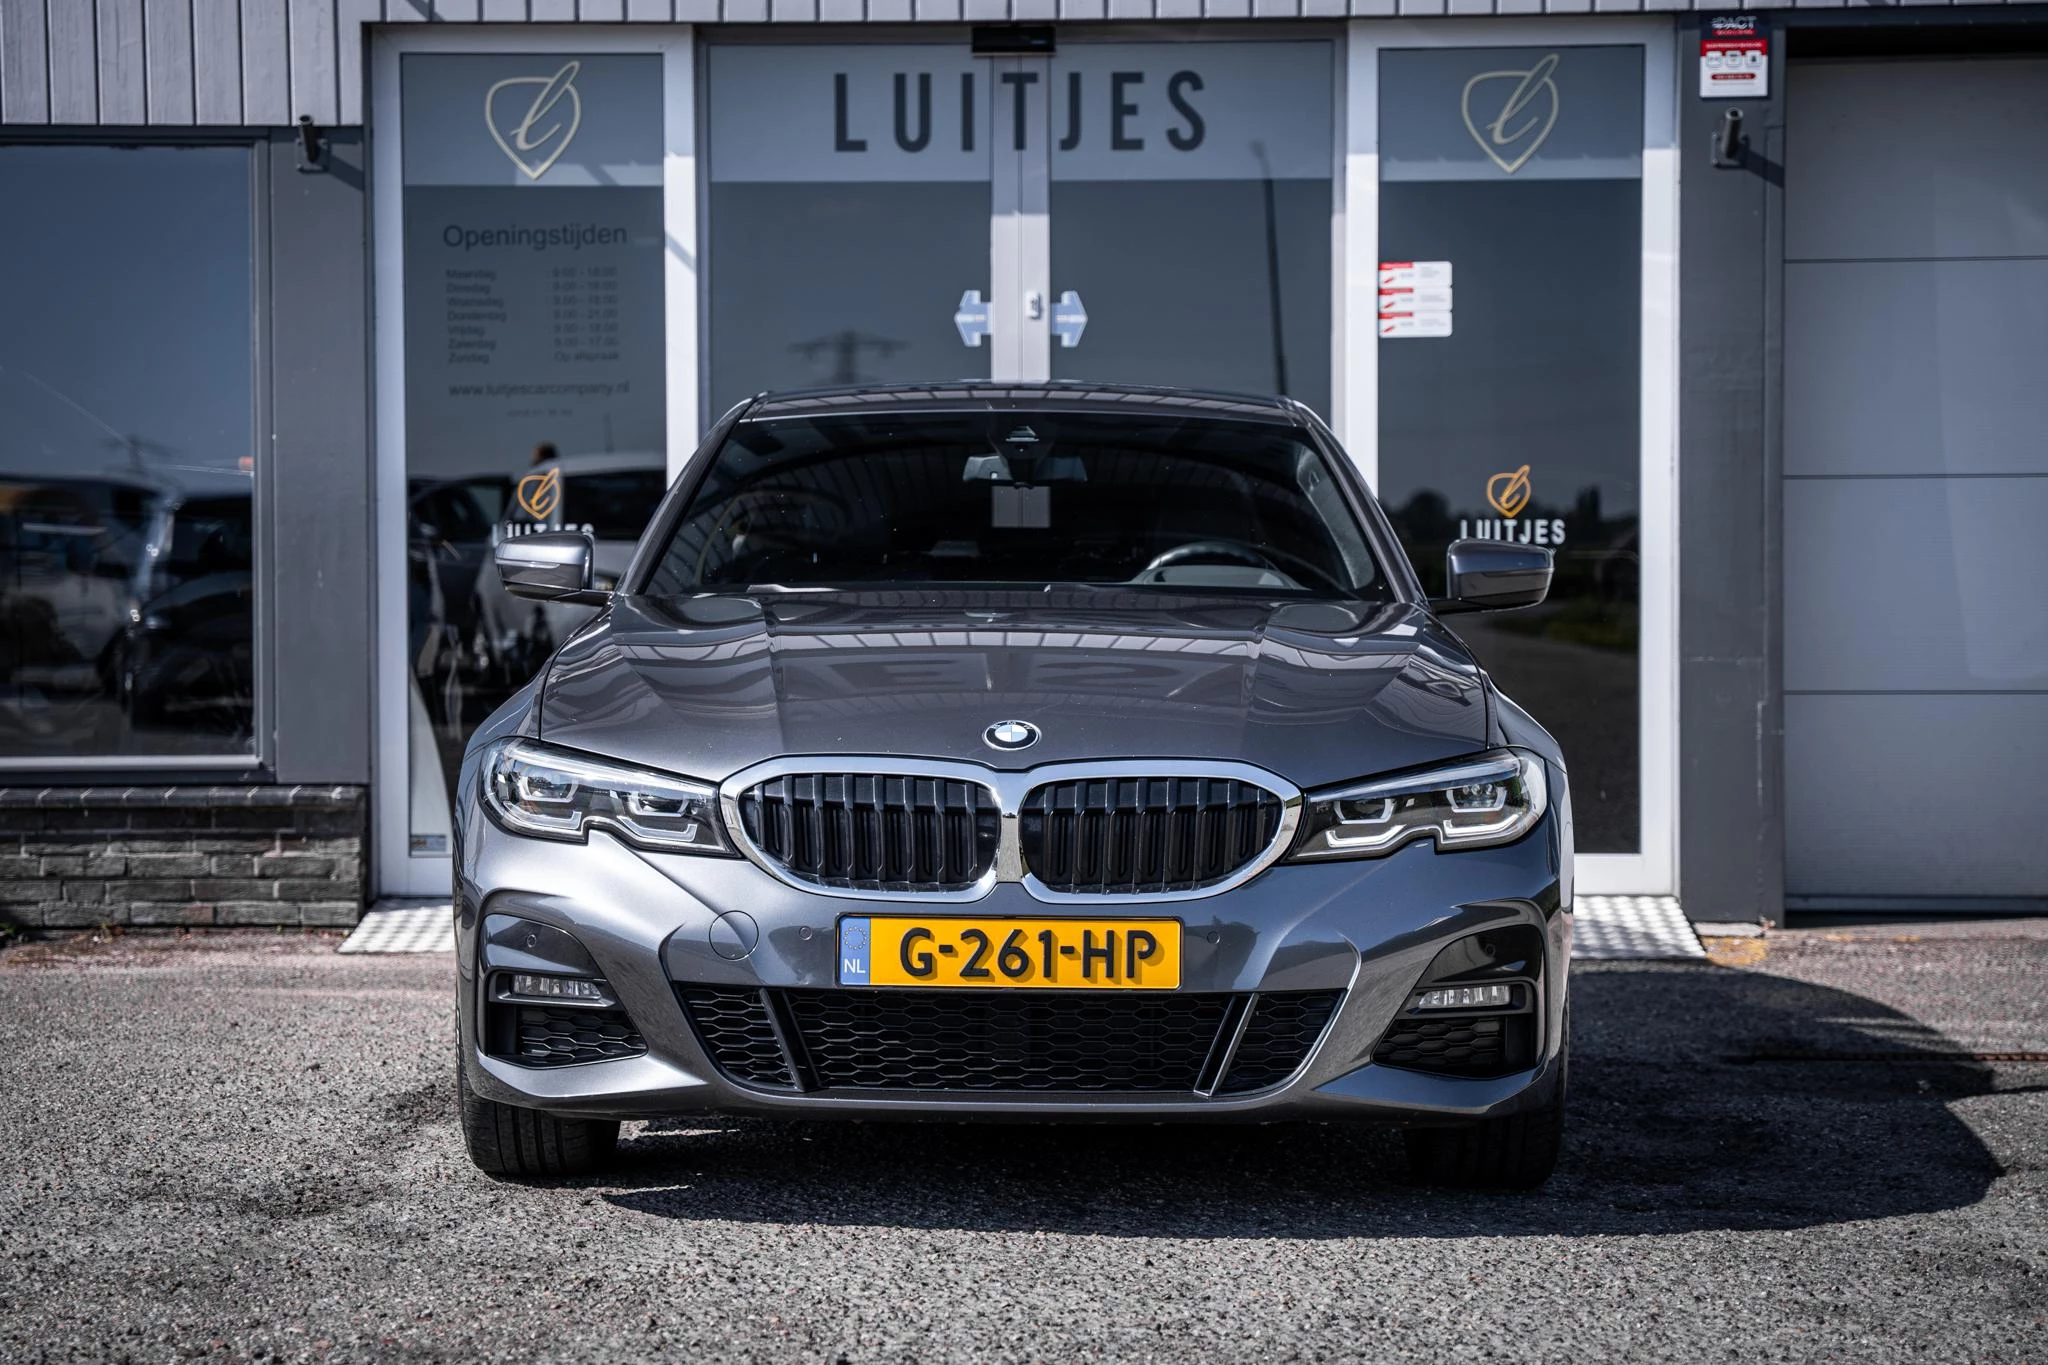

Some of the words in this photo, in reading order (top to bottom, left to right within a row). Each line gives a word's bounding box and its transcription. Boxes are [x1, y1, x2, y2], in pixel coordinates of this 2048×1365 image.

[834, 70, 1206, 152] LUITJES
[443, 222, 628, 252] Openingstijden
[1461, 519, 1566, 544] LUITJES
[843, 958, 867, 974] NL
[900, 927, 1158, 979] G-261-HP
